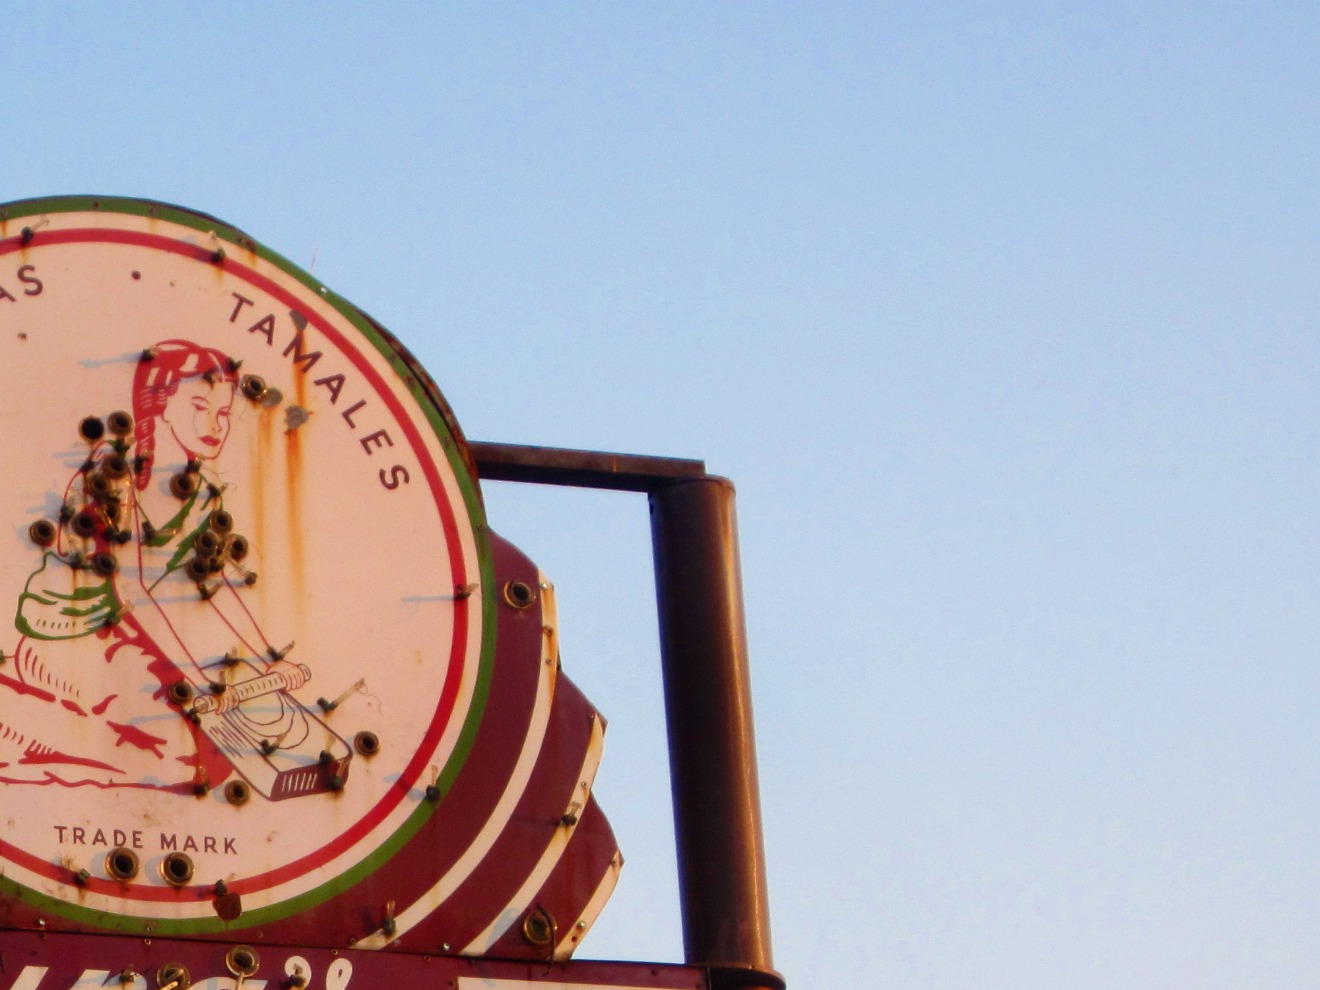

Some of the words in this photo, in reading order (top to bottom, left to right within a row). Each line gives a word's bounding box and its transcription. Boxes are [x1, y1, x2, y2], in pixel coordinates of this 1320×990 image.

[226, 291, 411, 492] TAMALES
[53, 825, 144, 850] TRADE
[160, 831, 238, 855] MARK
